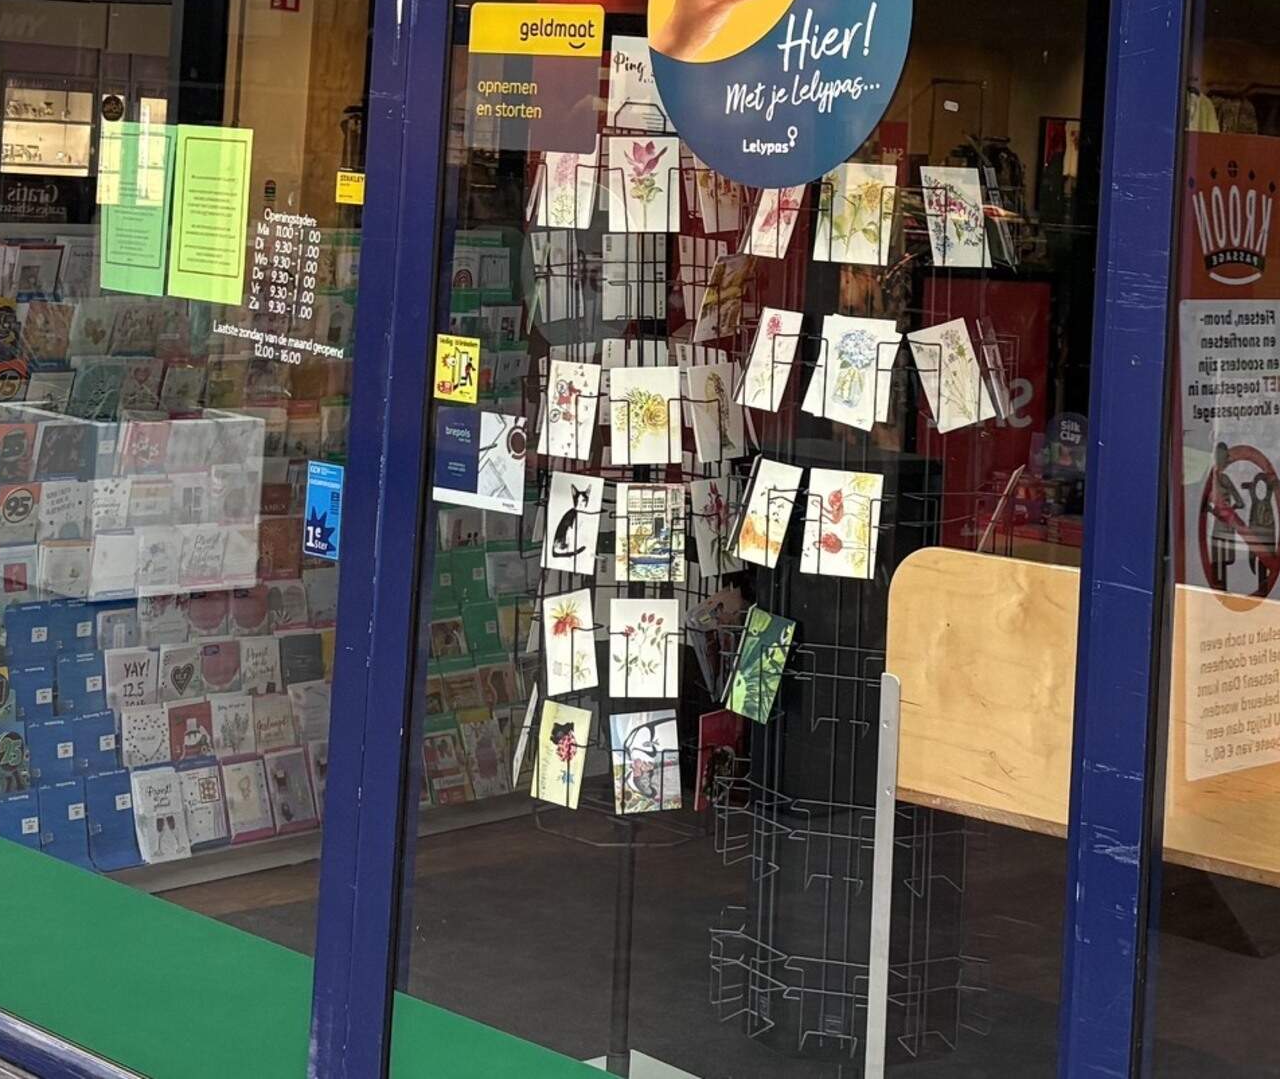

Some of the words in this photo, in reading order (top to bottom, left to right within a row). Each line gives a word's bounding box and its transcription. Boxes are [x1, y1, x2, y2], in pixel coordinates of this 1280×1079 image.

[519, 19, 596, 42] geldmaat
[777, 2, 877, 72] Hier!
[477, 79, 538, 98] opnemen
[476, 103, 492, 116] en
[495, 101, 542, 120] storten
[725, 81, 766, 116] Met
[767, 87, 789, 121] je
[742, 138, 790, 157] Lelypas
[265, 333, 278, 343] van
[278, 334, 287, 346] de
[288, 337, 312, 352] maand
[313, 341, 344, 359] geopend
[123, 658, 150, 678] YAY!
